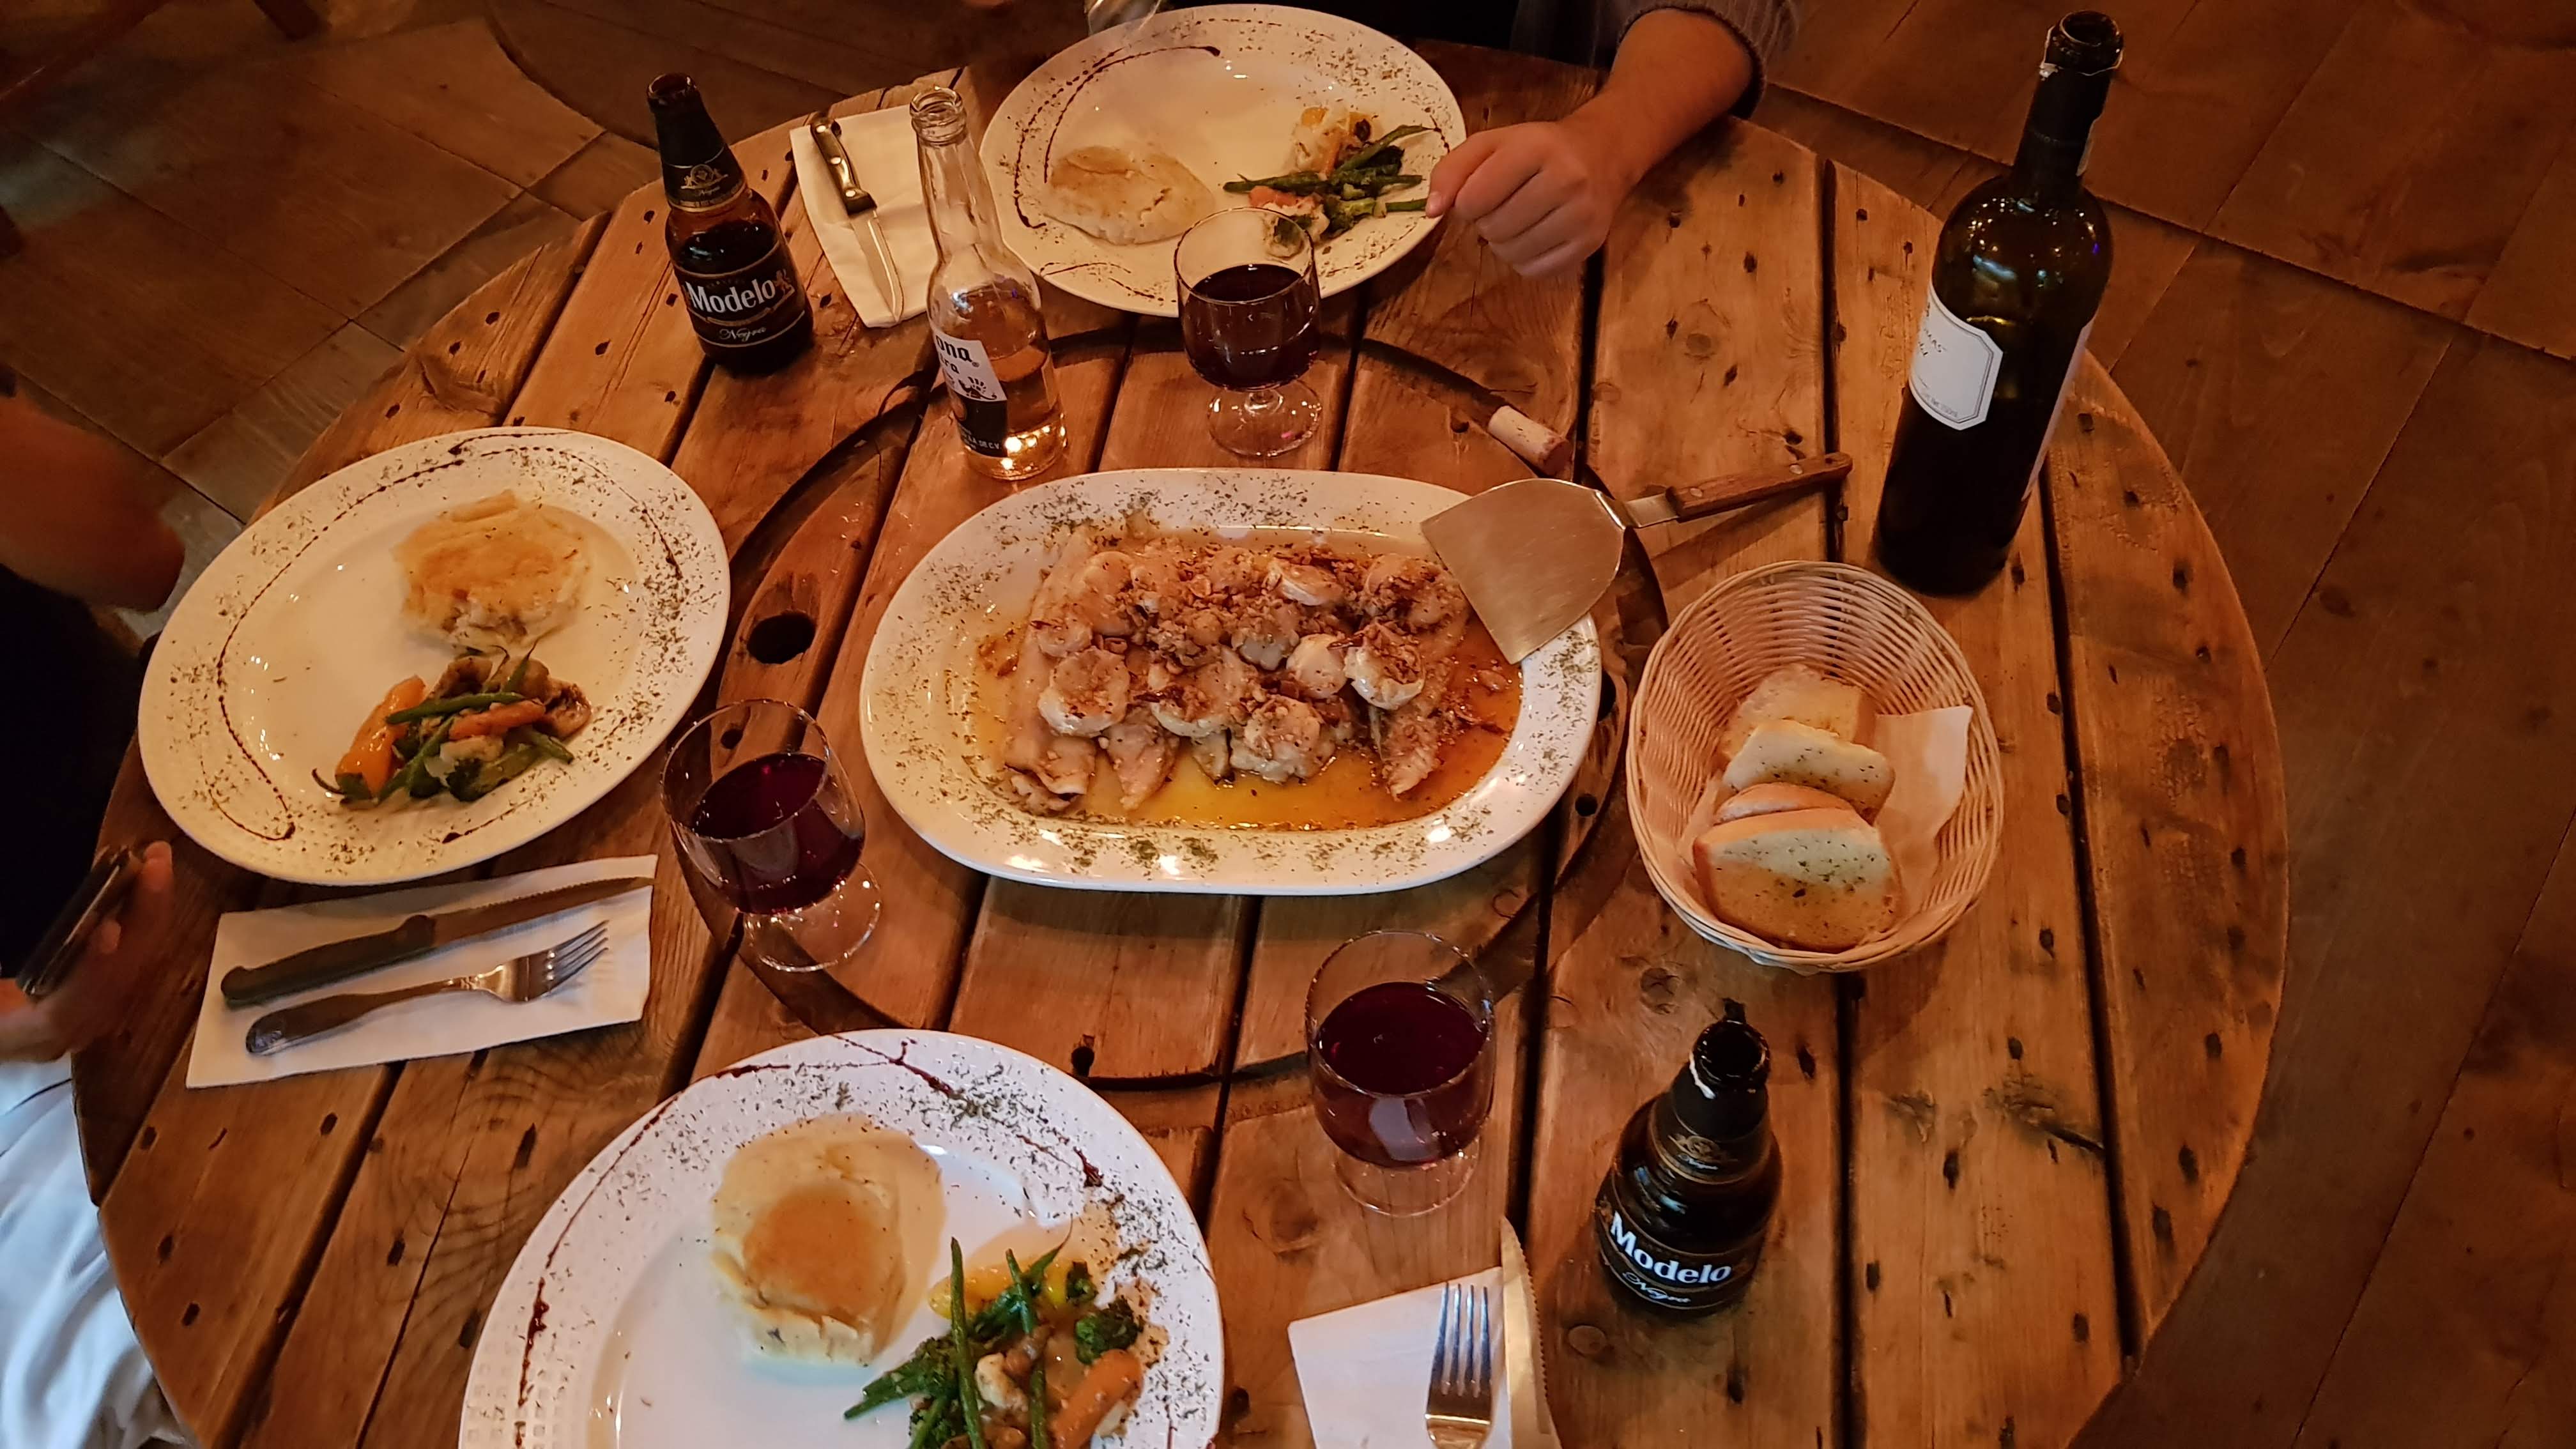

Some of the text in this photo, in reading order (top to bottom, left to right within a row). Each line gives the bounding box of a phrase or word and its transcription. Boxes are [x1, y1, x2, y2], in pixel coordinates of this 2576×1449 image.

[685, 279, 776, 313] Modelo
[719, 326, 767, 342] Negra
[1611, 1211, 1732, 1284] Modelo
[1622, 1271, 1692, 1303] Negra
